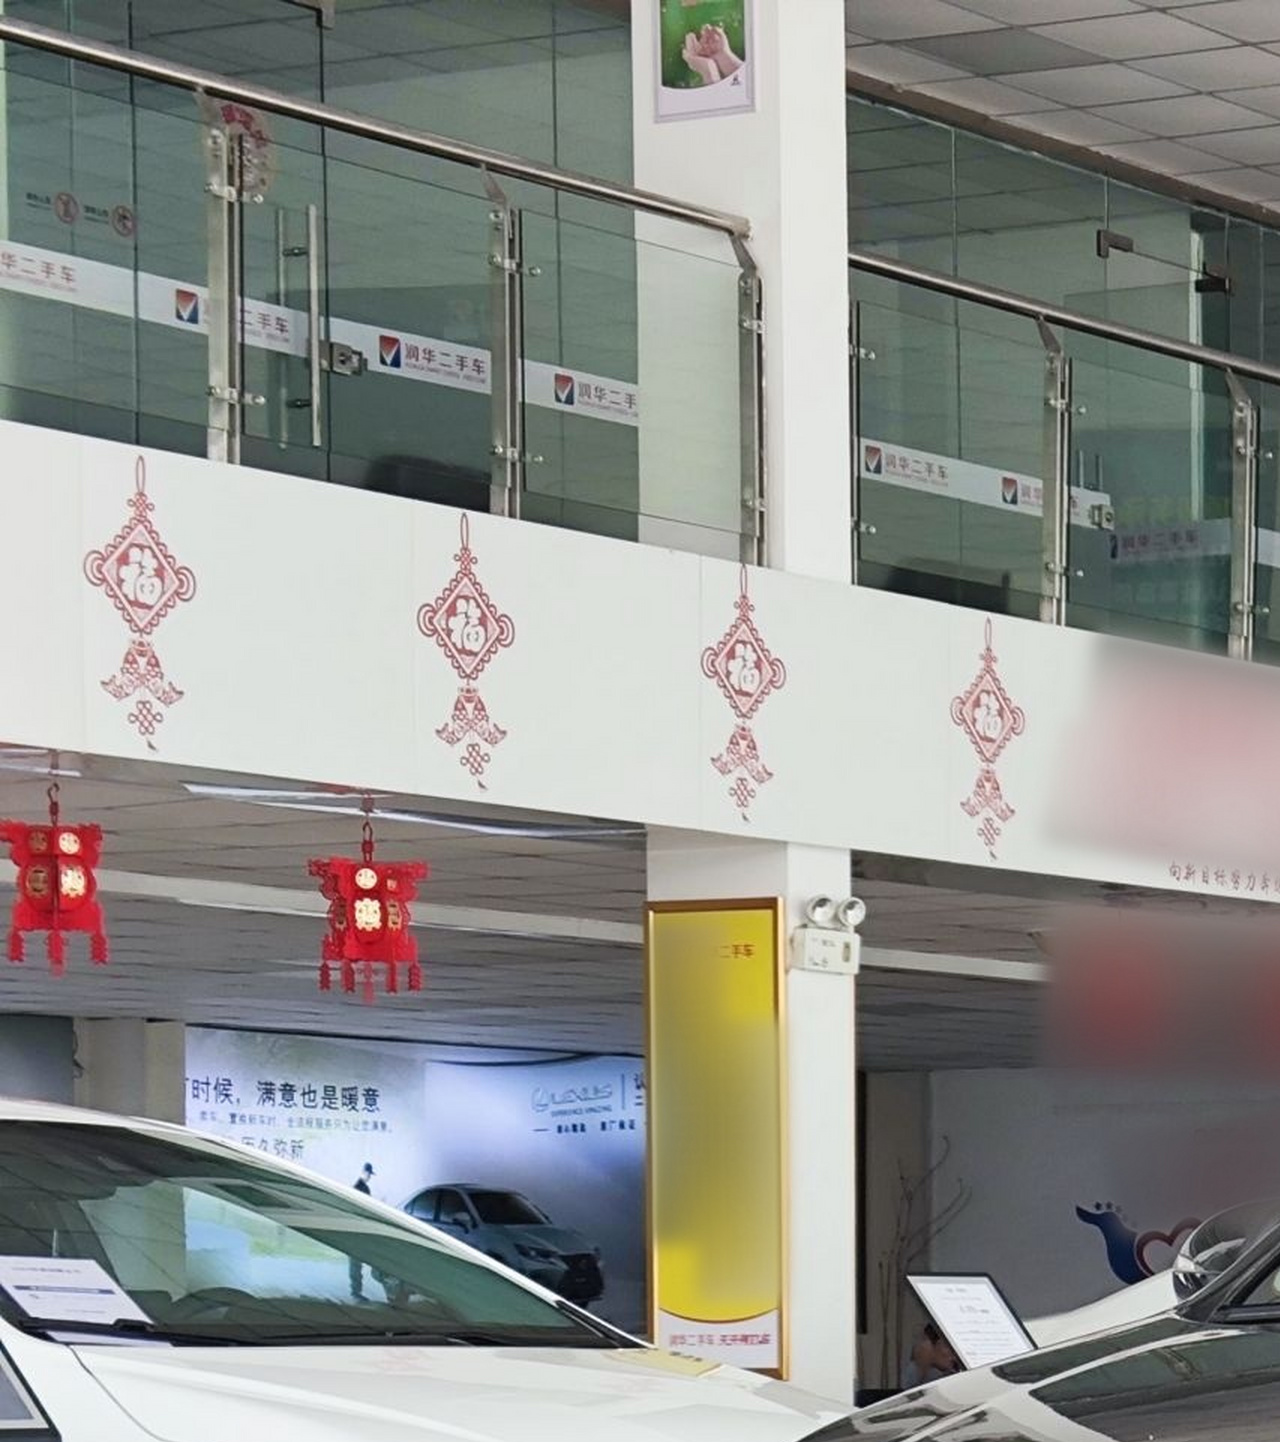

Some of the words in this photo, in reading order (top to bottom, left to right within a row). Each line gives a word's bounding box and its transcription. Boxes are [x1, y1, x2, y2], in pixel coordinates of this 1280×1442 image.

[404, 342, 487, 375] 润华二手车
[185, 1076, 381, 1113] 时候，满意也是暖意
